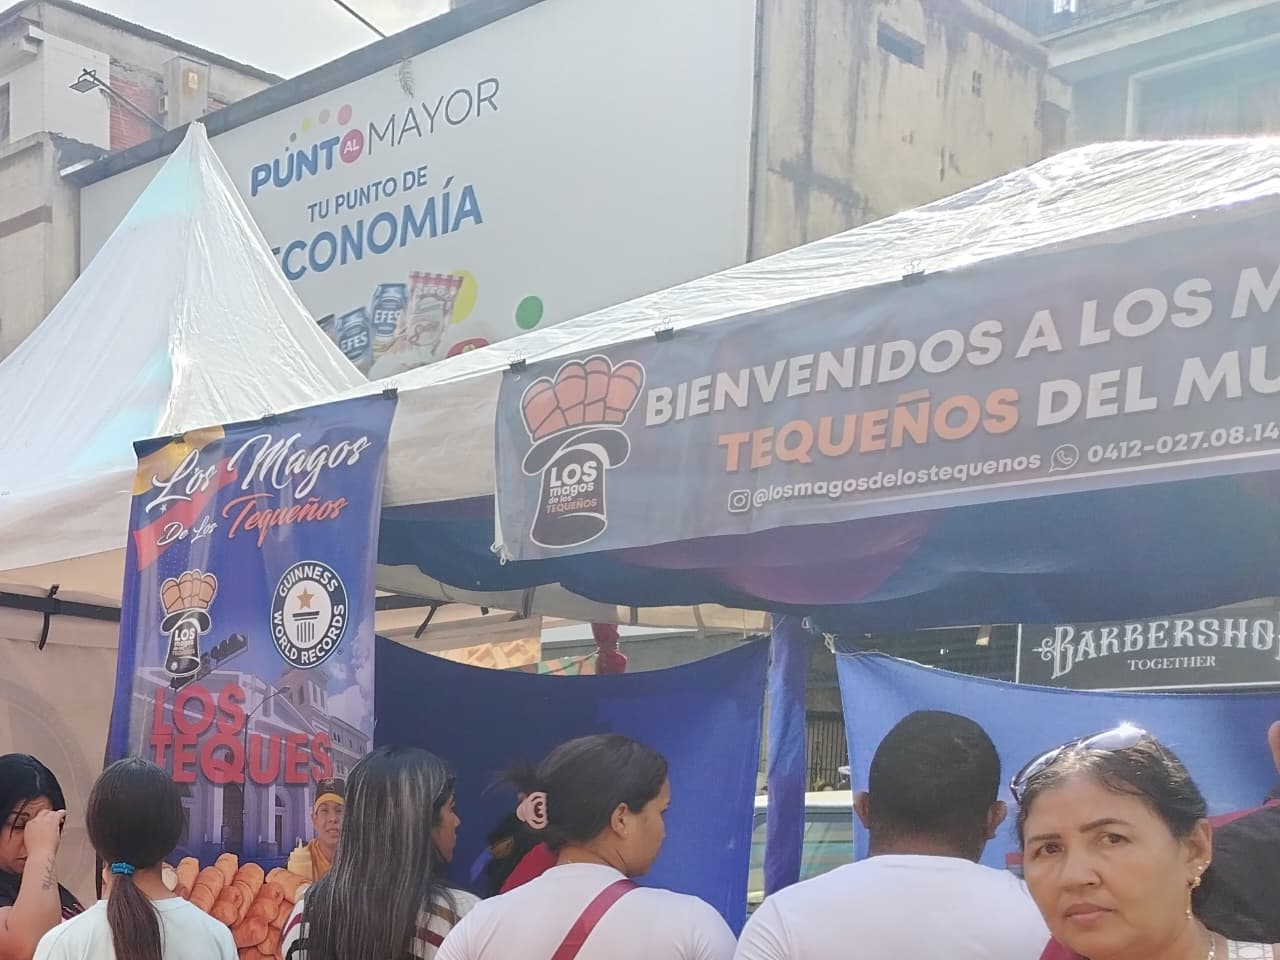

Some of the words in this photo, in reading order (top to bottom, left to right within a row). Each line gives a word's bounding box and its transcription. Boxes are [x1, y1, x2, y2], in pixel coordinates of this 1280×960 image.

[343, 140, 360, 154] AL
[368, 78, 500, 156] MAYOR
[307, 199, 329, 223] TU
[335, 177, 397, 214] PUNTO
[402, 165, 428, 192] DE
[271, 175, 483, 281] CONOMÍA
[645, 320, 1002, 427] BIENVENIDOS
[1016, 309, 1063, 358] A
[1079, 277, 1213, 347] LOS
[718, 388, 1019, 473] TEQUEÑOS
[1037, 366, 1158, 427] DEL
[146, 449, 218, 514] Los
[227, 433, 371, 499] Magos
[549, 460, 598, 488] LOS
[549, 482, 595, 498] magos
[752, 453, 1041, 508] @losmagosdelostequenos
[157, 522, 188, 546] De
[191, 515, 218, 544] Los
[222, 493, 348, 548] Tequeños
[545, 497, 598, 514] TEQUEÑOS
[279, 565, 338, 597] GUINNESS
[174, 627, 195, 642] LOS
[274, 610, 298, 660] WORLD
[301, 604, 345, 664] RECORDS
[1128, 655, 1217, 671] TOGETHER
[152, 683, 247, 737] LOS
[150, 731, 333, 786] TEQUES
